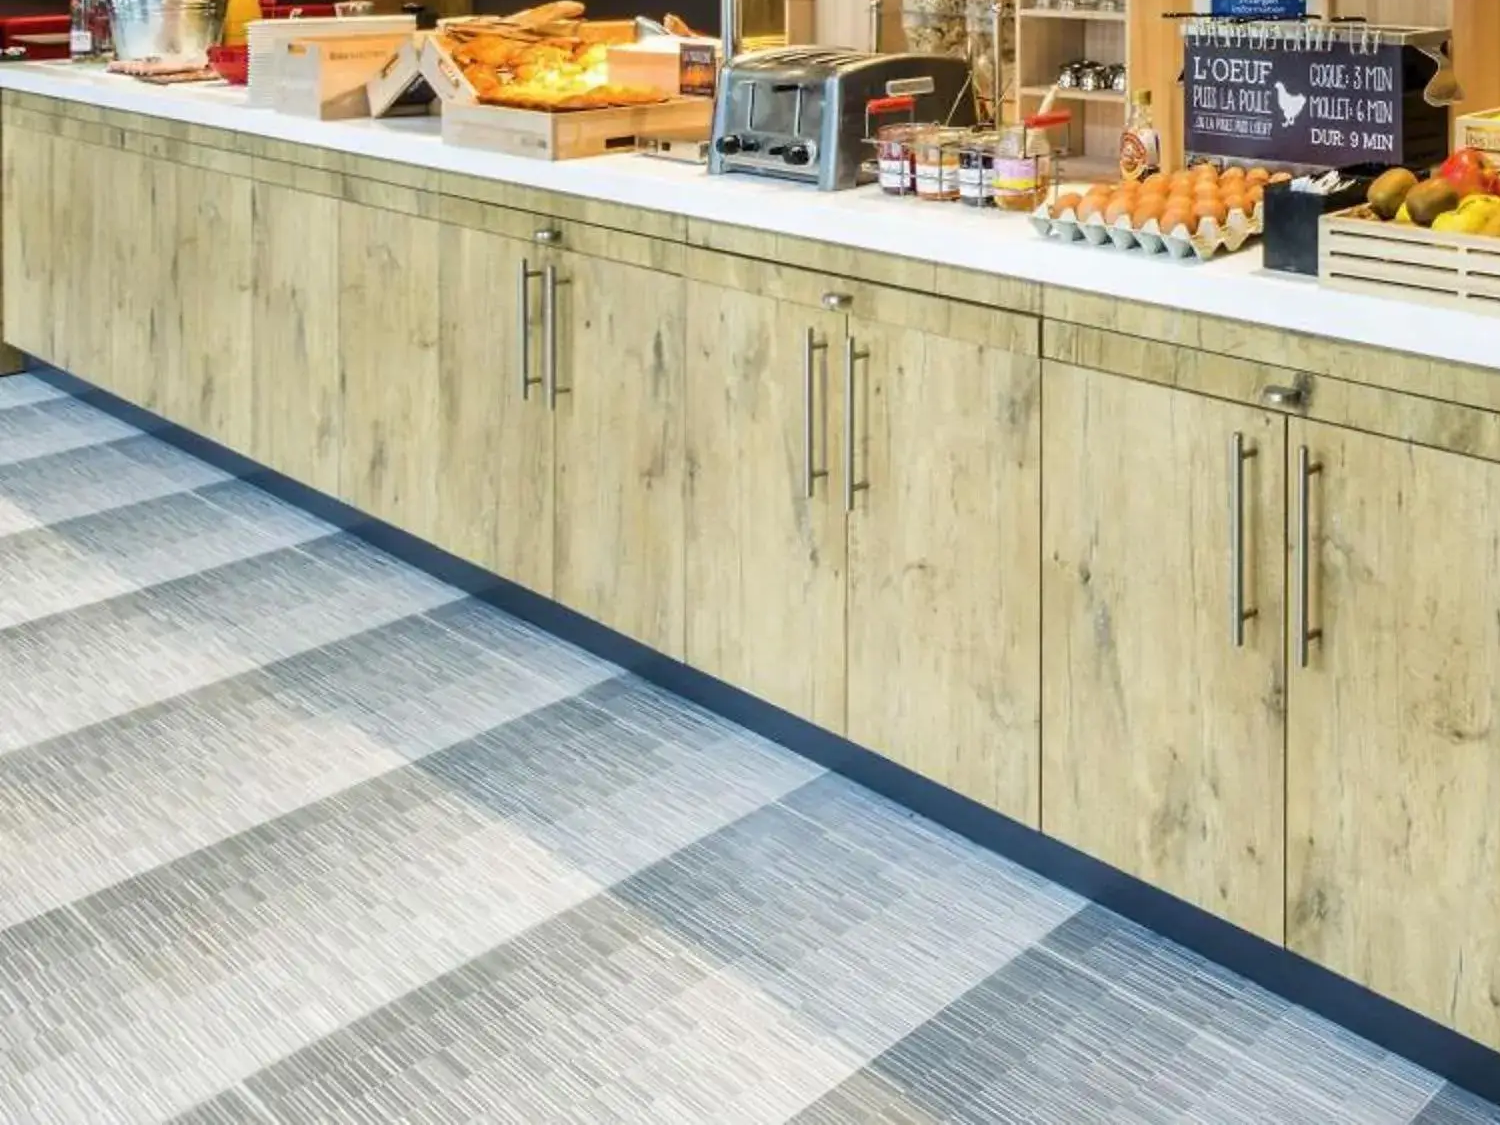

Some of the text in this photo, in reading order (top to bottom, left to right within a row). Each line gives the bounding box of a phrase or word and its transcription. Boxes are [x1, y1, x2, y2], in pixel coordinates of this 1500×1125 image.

[1193, 56, 1273, 84] L'OEUF
[1353, 65, 1363, 90] 3
[1365, 66, 1393, 92] MIN
[1221, 87, 1235, 112] LA
[1239, 88, 1272, 114] POULE
[1309, 96, 1393, 124] MOLLET: 6 MIN
[1311, 128, 1394, 152] DUR: 9 MIN
